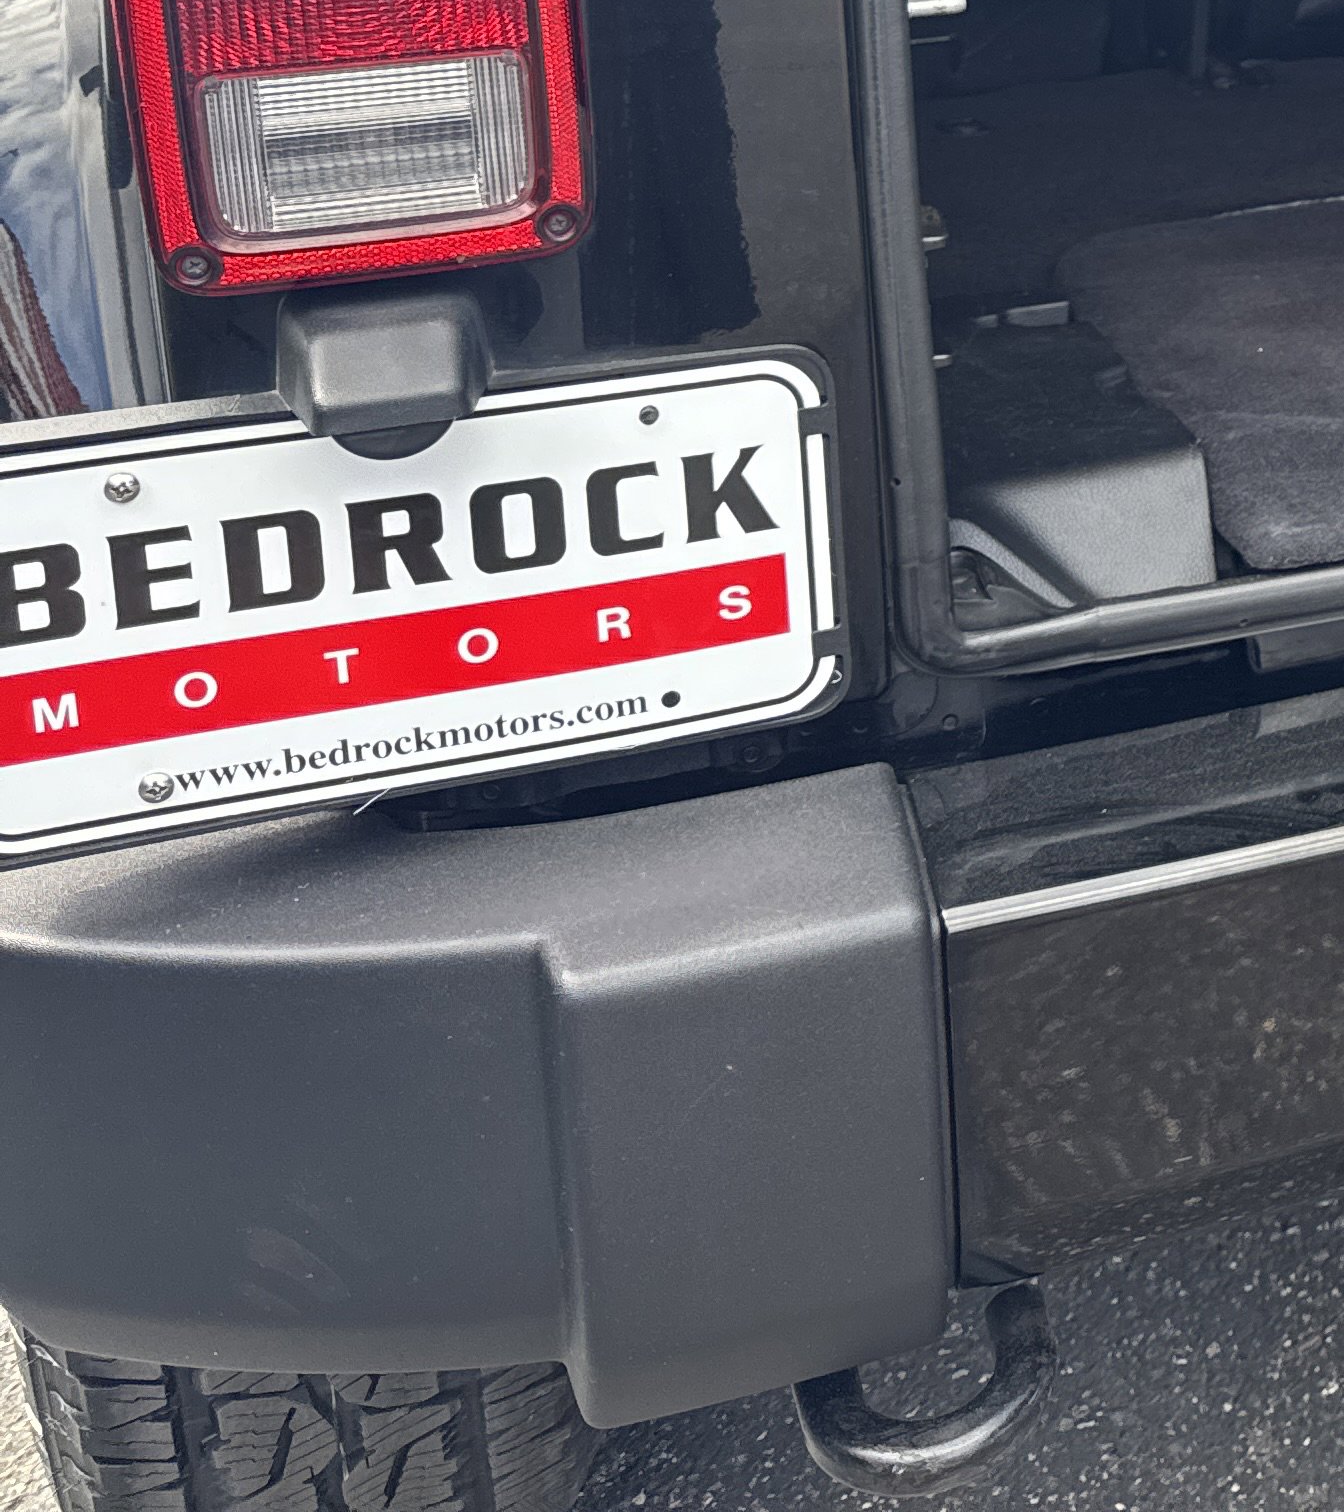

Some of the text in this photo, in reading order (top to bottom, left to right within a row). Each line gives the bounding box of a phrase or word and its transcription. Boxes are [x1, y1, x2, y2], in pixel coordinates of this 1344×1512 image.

[0, 444, 779, 648] BEDROCK
[32, 584, 753, 734] MOTORS
[174, 693, 648, 792] www.bedrockmotors.com
